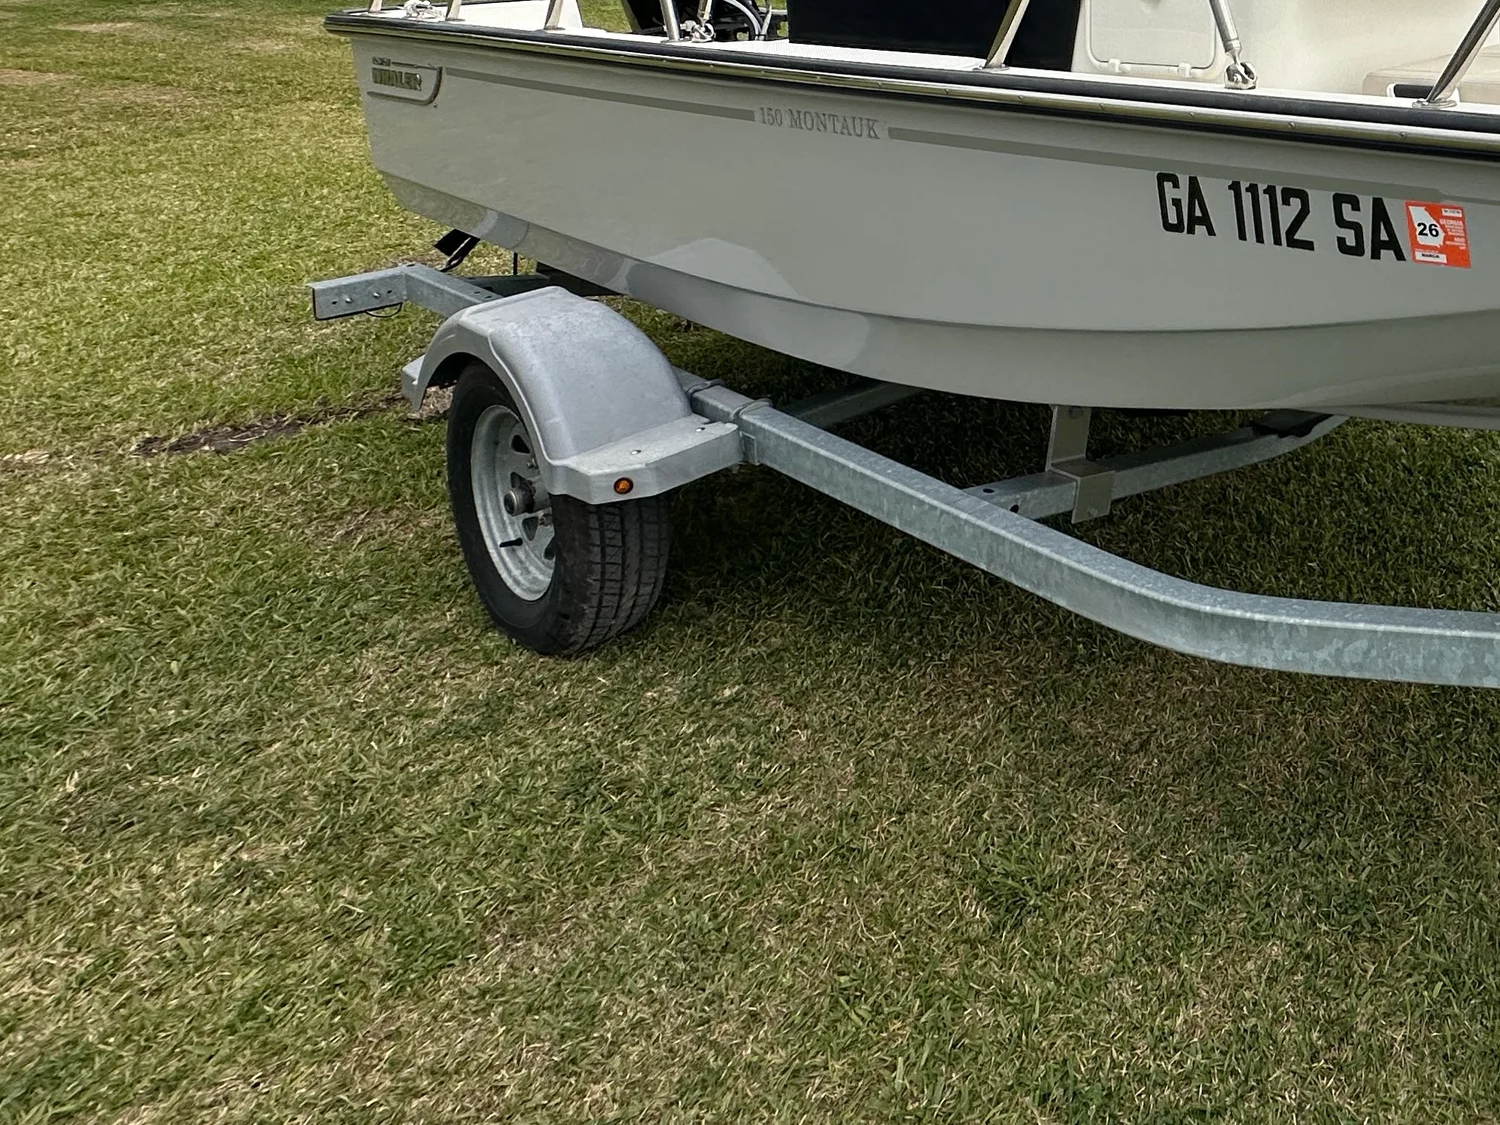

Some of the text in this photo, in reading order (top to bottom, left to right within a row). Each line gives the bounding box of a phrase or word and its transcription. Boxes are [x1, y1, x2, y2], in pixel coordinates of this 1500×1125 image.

[759, 106, 880, 140] 150 MONTAUK
[1156, 172, 1406, 262] GA 1112 SA
[1417, 222, 1439, 238] 26
